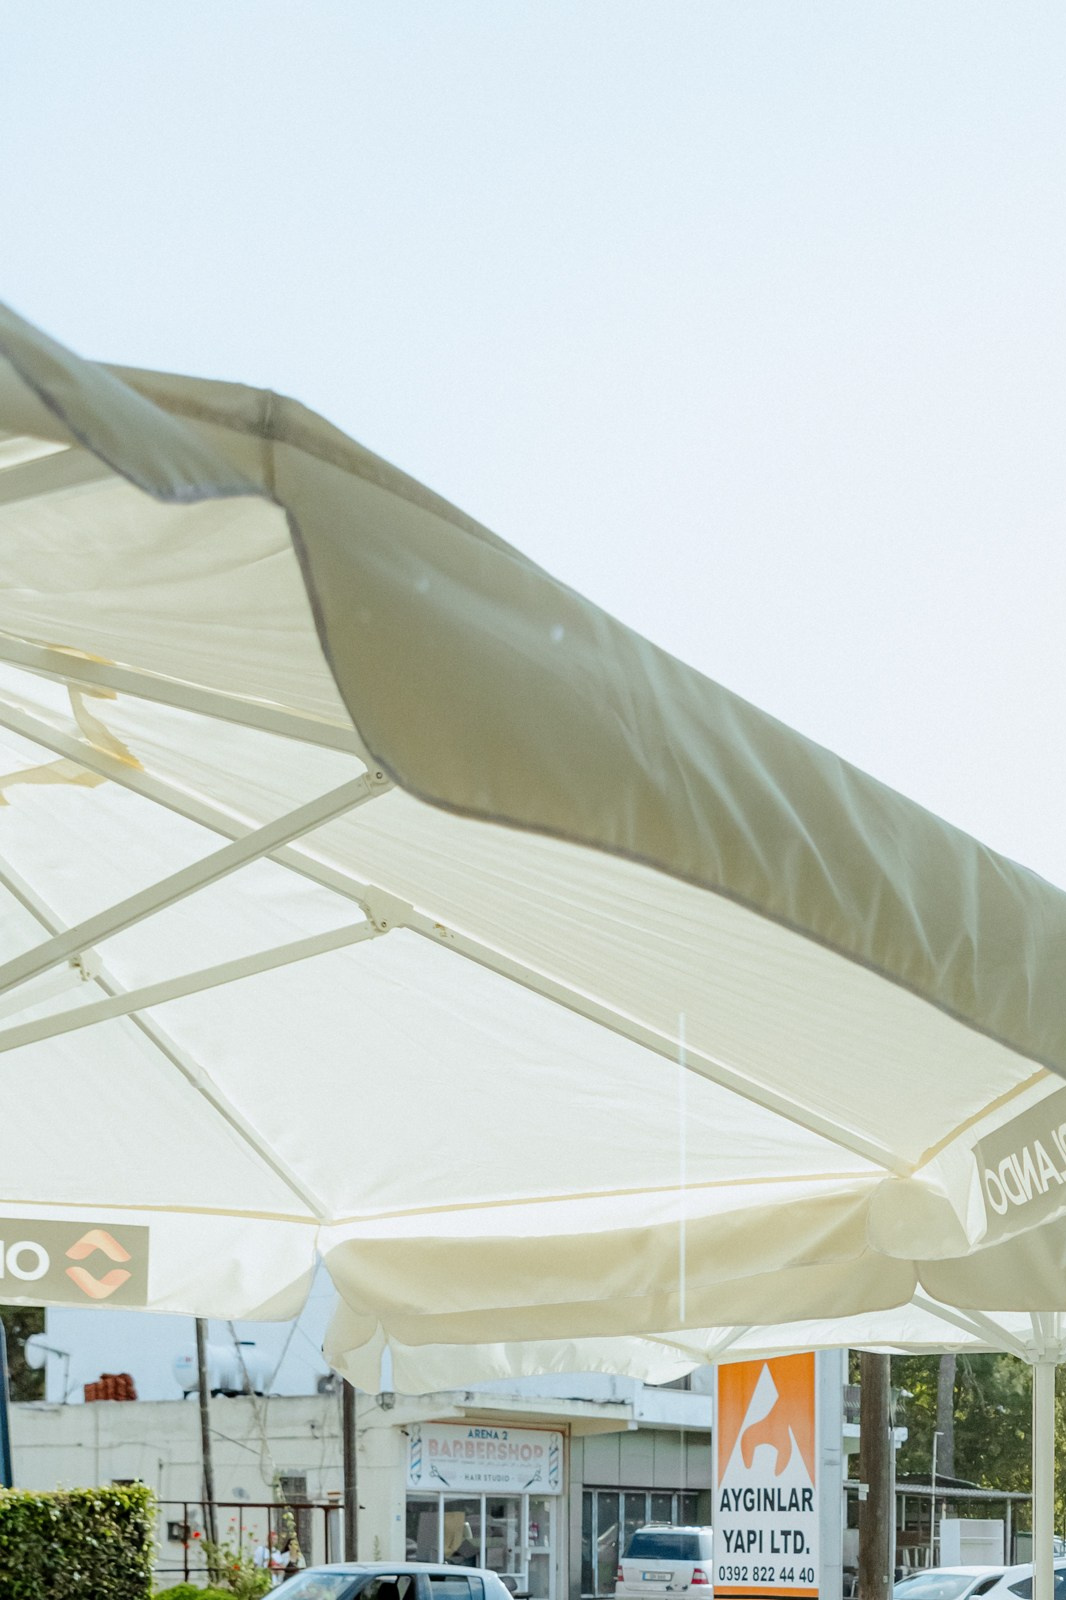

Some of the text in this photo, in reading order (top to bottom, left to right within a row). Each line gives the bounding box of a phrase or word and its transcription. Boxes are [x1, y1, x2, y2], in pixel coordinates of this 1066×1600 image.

[467, 1428, 508, 1441] ARENA 2
[428, 1438, 544, 1461] BARBERSHOP
[484, 1474, 510, 1482] STUDIO
[719, 1488, 815, 1512] AYGINLAR
[722, 1530, 810, 1554] YAPI LTD.
[719, 1566, 815, 1583] 0392 822 44 40
